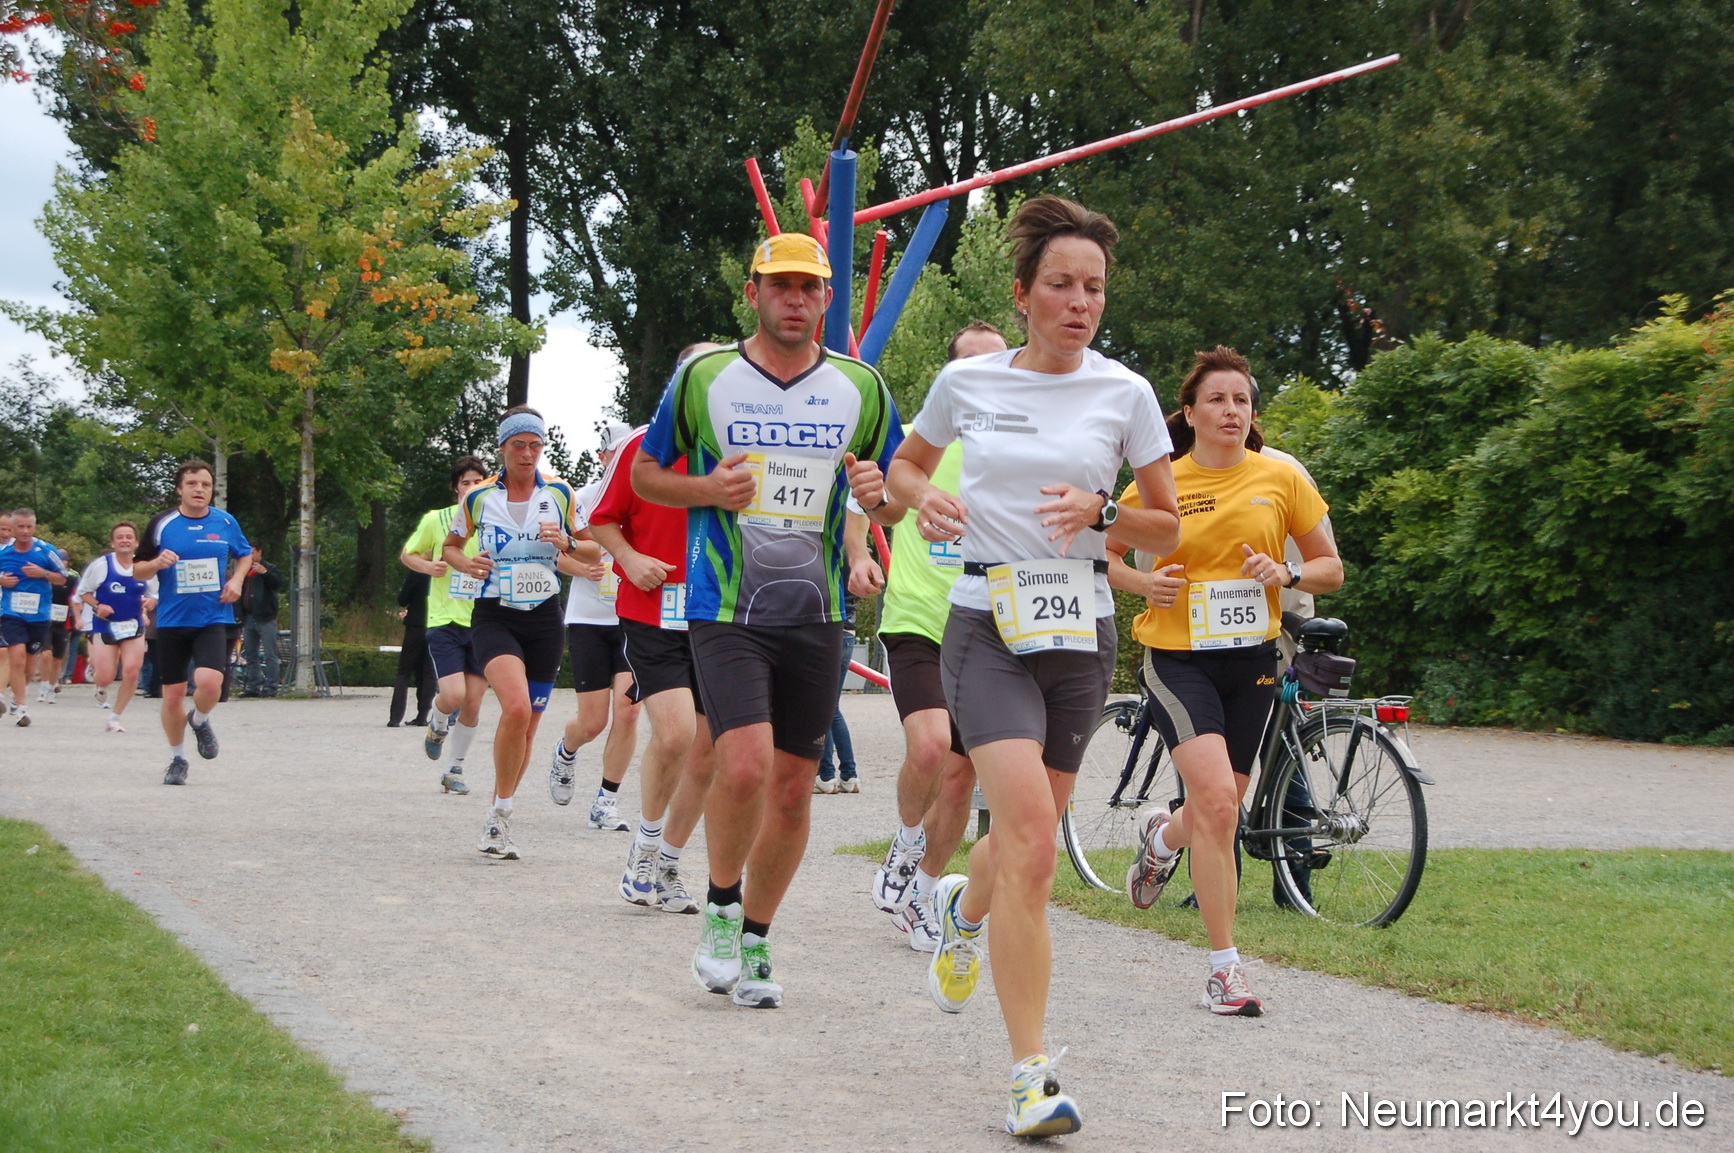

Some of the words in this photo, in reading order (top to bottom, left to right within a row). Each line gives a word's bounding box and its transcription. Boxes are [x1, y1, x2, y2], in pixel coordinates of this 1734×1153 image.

[731, 402, 783, 415] TEAM
[728, 420, 846, 449] BOCK
[768, 461, 807, 478] Helmut
[773, 485, 815, 507] 417
[189, 571, 214, 581] 3142
[517, 571, 545, 580] ANNE
[1017, 570, 1069, 587] Simone
[516, 581, 551, 594] 2002
[1210, 587, 1261, 600] Annemarie
[997, 601, 1004, 615] B
[1032, 595, 1082, 620] 294
[1192, 608, 1198, 618] B
[1220, 606, 1256, 625] 555
[1064, 635, 1096, 645] PFLEIDERER
